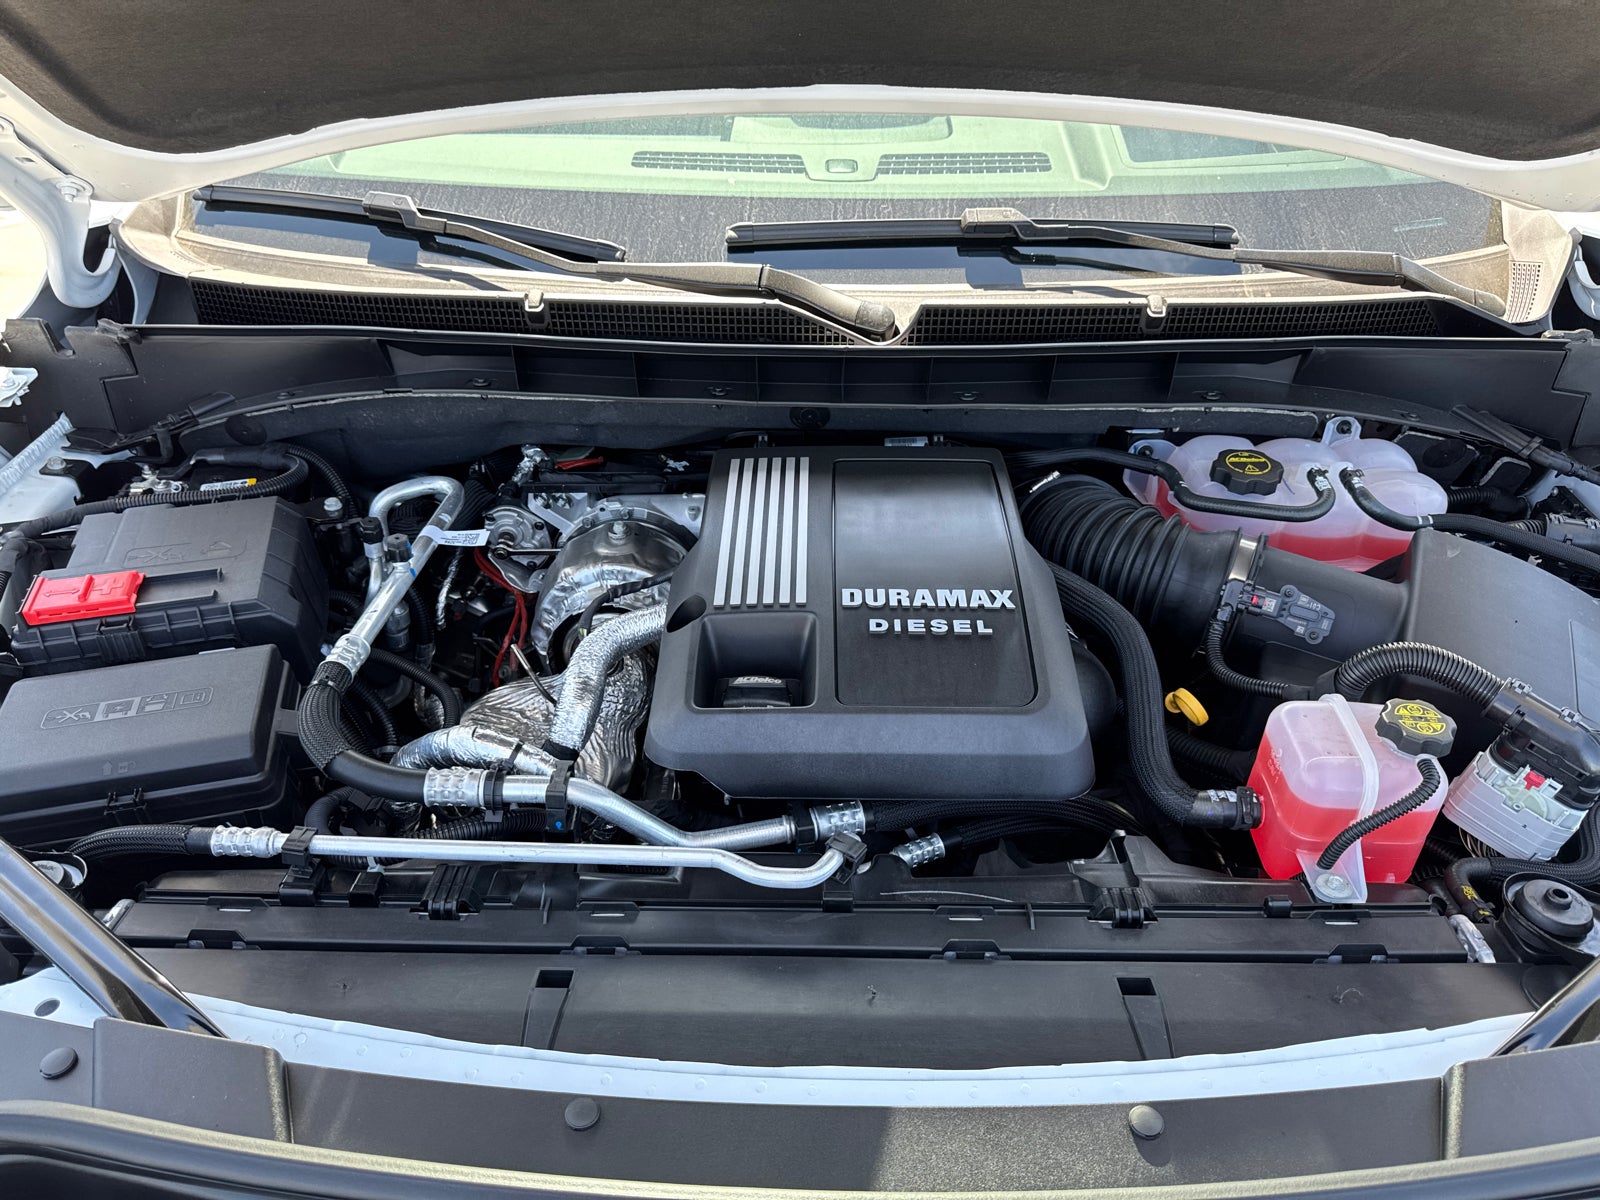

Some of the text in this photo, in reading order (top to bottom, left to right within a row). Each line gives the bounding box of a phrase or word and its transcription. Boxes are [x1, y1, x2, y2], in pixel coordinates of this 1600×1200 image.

[841, 588, 1016, 610] DURAMAX
[869, 618, 993, 635] DIESEL
[732, 676, 782, 684] ACDelco
